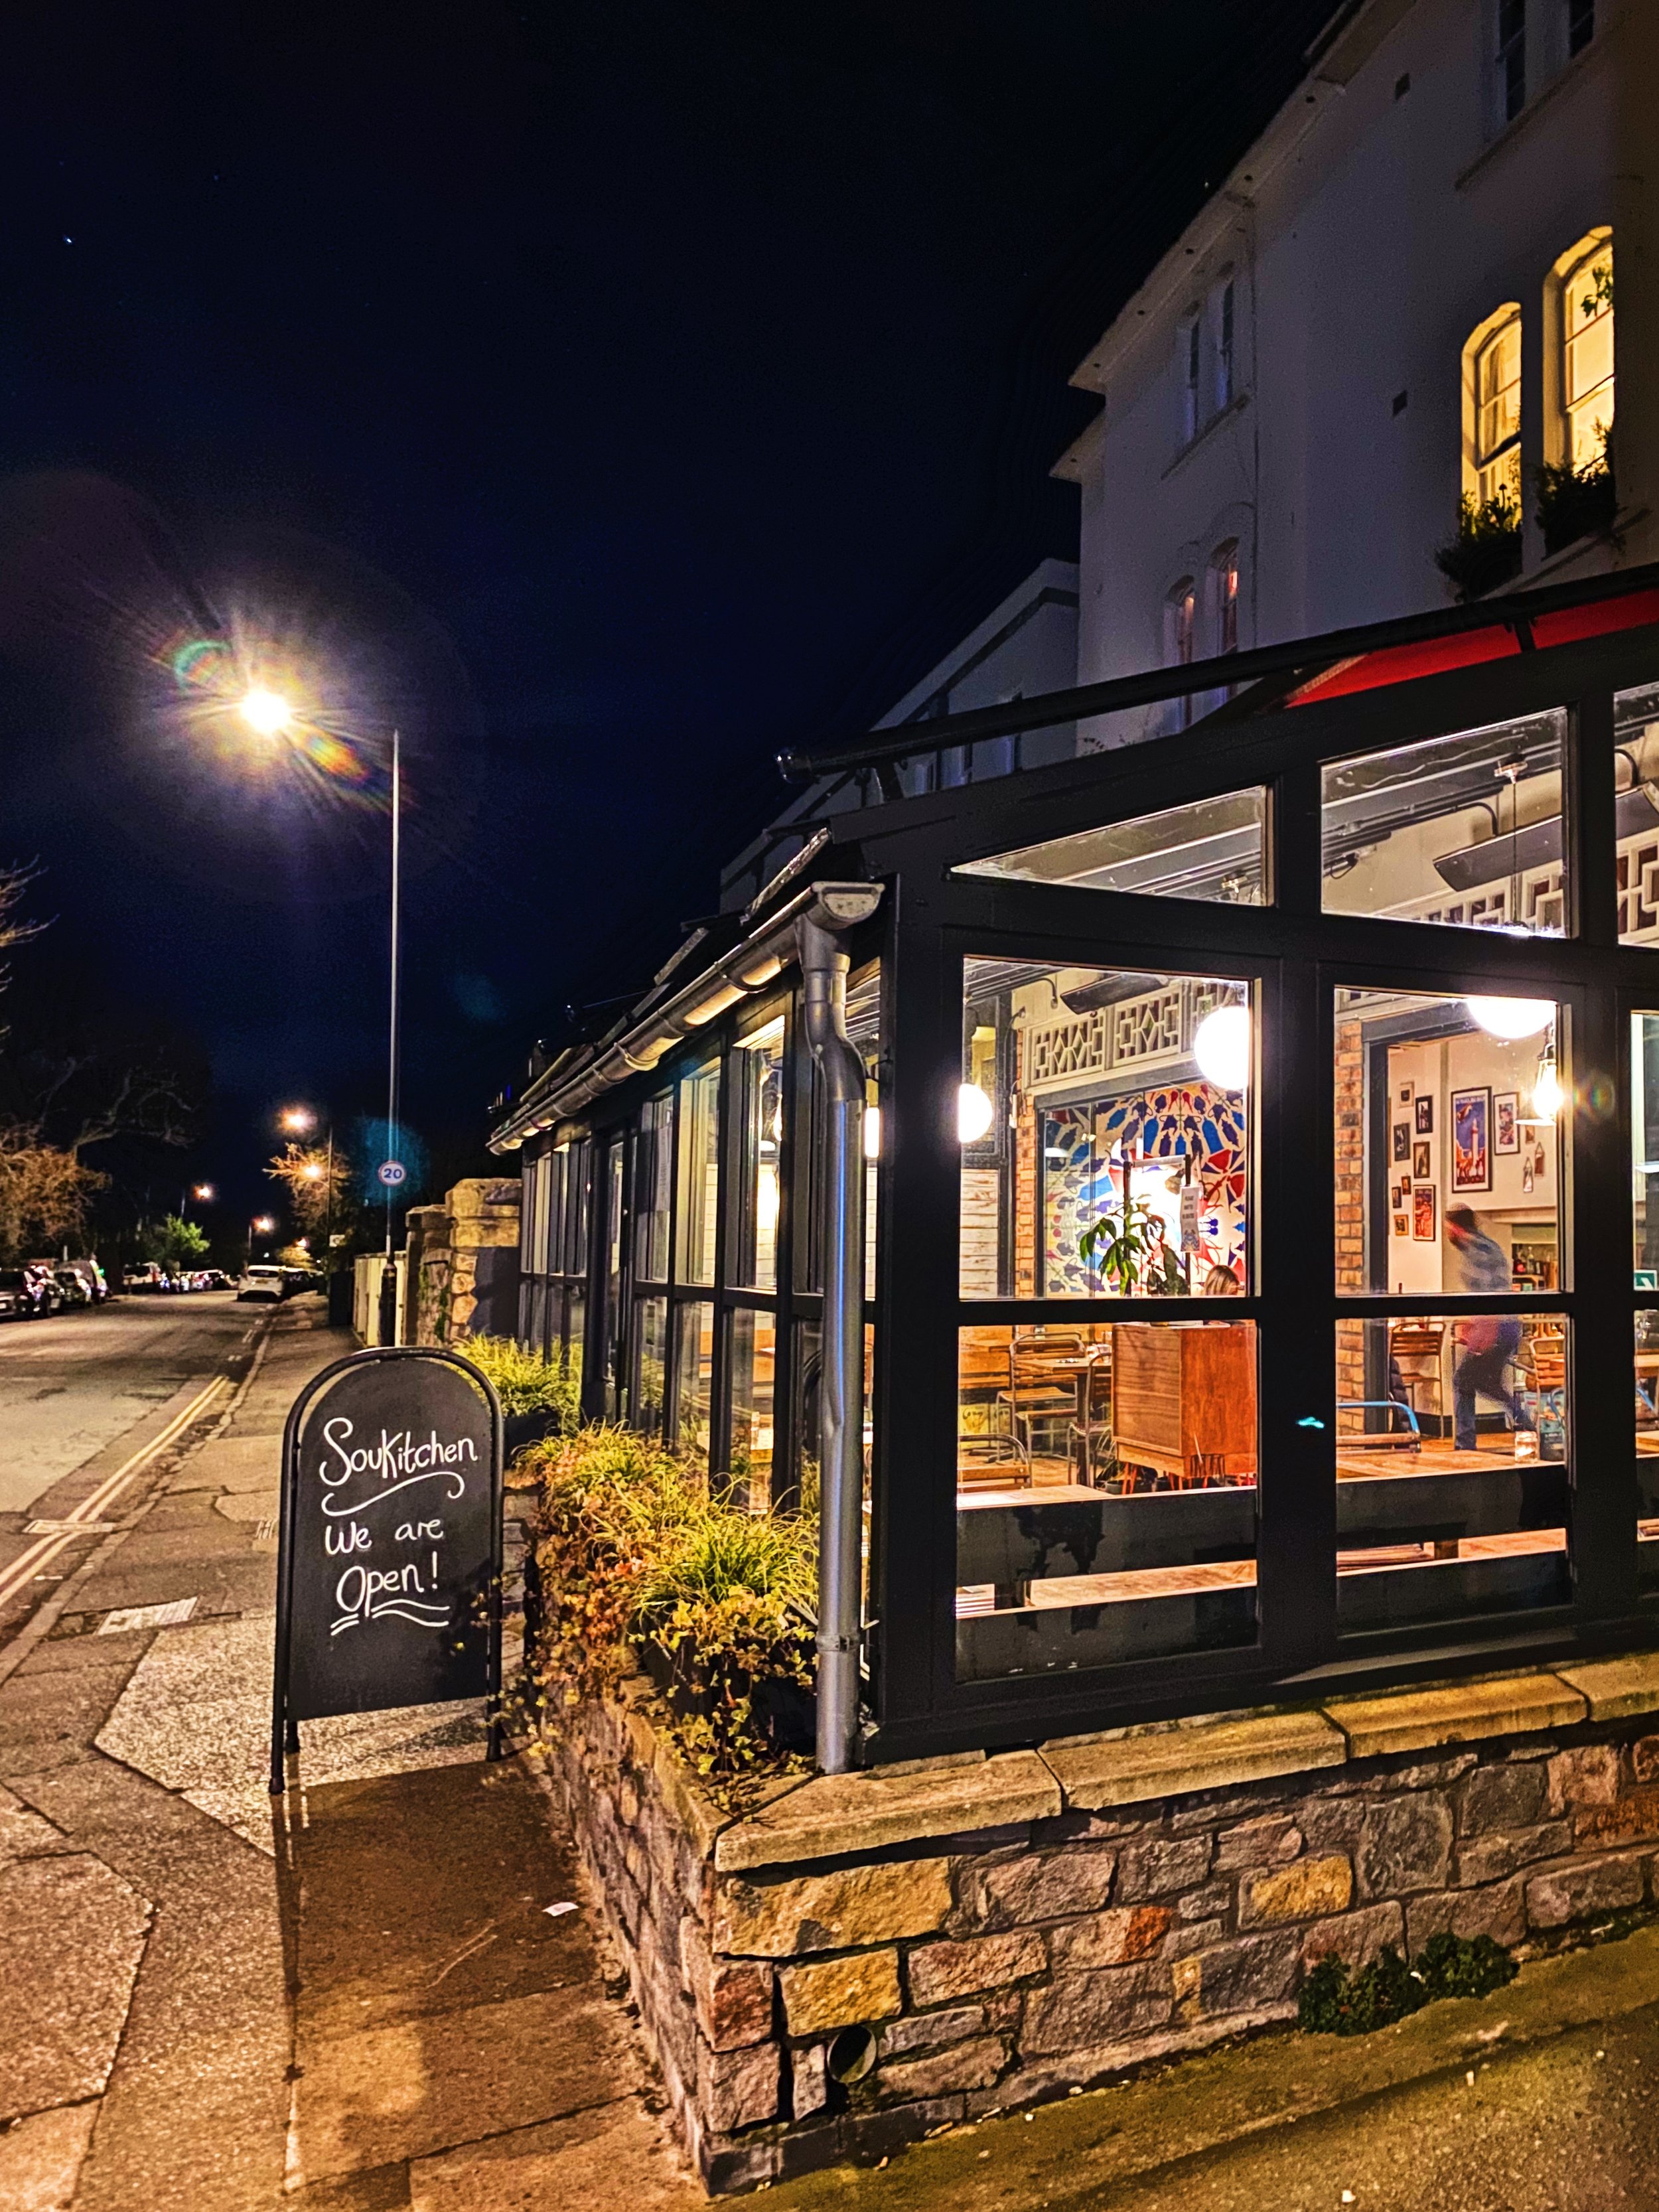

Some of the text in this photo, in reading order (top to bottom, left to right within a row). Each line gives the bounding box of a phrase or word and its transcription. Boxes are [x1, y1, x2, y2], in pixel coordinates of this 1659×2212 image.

[384, 1168, 402, 1179] 20
[319, 1417, 478, 1487] SouKitchen
[325, 1518, 444, 1555] We are
[336, 1551, 438, 1617] Open!
